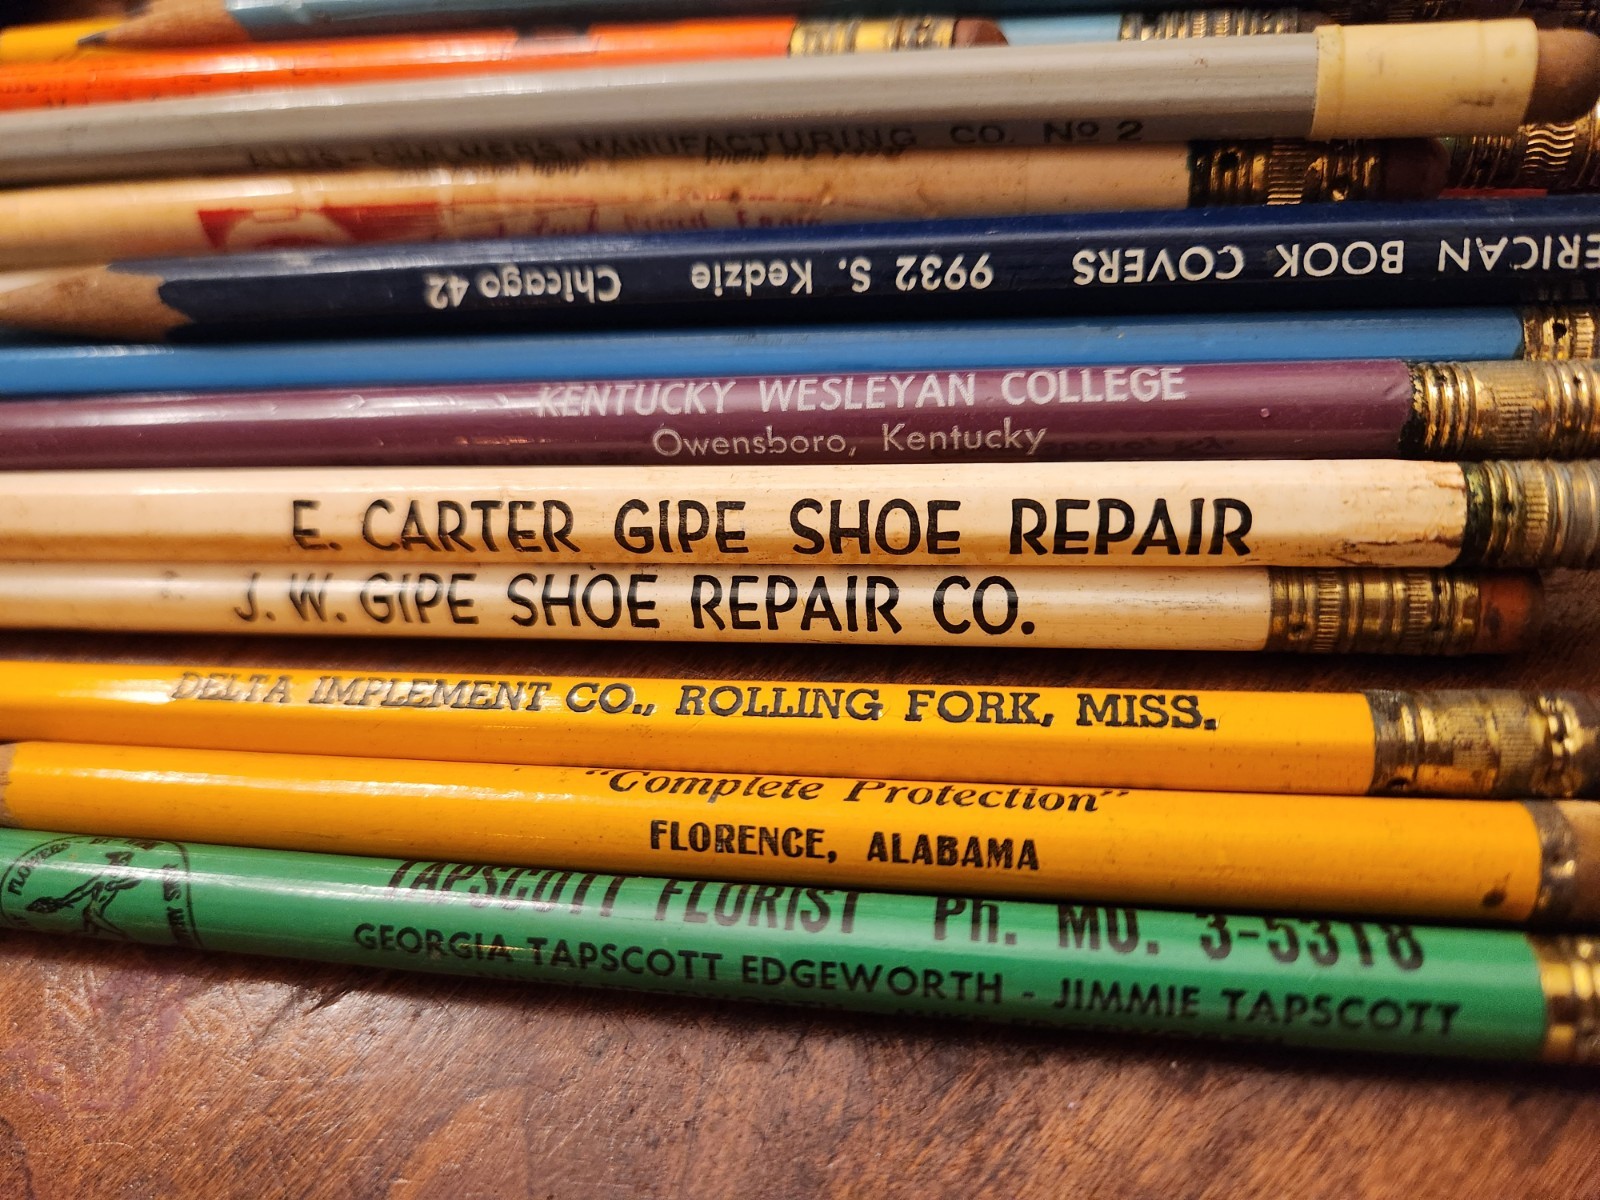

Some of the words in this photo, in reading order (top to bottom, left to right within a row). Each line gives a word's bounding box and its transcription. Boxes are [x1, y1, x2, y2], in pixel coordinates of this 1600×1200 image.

[1115, 119, 1144, 142] 2
[690, 257, 814, 298] Kedzie
[837, 254, 872, 294] S.
[894, 251, 995, 292] 9932
[1072, 244, 1246, 287] COVERS
[1273, 239, 1405, 278] BOOK
[424, 272, 470, 311] 42
[474, 262, 623, 304] Chicago
[536, 380, 737, 418] KENTUCKY
[758, 372, 977, 413] WESLEYAN
[1000, 366, 1188, 406] COLLEGE
[651, 425, 857, 458] Owensboro,
[881, 416, 1048, 456] Kentucky
[293, 499, 343, 551] E.
[362, 498, 582, 553] CARTER
[614, 498, 750, 554] GIPE
[789, 498, 962, 555] SHOE
[1009, 497, 1253, 556] REPAIR
[360, 571, 481, 625] GIPE
[507, 573, 661, 629] SHOE
[690, 574, 903, 634] REPAIR
[932, 575, 1036, 635] CO.
[171, 671, 294, 703] DELTA
[308, 675, 554, 713] IMPLEMENT
[566, 682, 656, 717] CO.,
[675, 684, 885, 720] ROLLING
[903, 689, 1054, 728] FORK,
[1075, 692, 1219, 731] MISS.
[650, 819, 838, 864] FLORENCE,
[867, 830, 1041, 871] ALABAMA
[654, 877, 863, 935] FLORIST
[934, 895, 1018, 945] Ph.
[353, 922, 515, 964] GEORGIA
[526, 936, 724, 981] TAPSCOTT
[741, 954, 1005, 1005] EDGEWORTH
[1053, 976, 1202, 1019] JIMMIE
[1220, 987, 1462, 1036] TAPSCOTT
